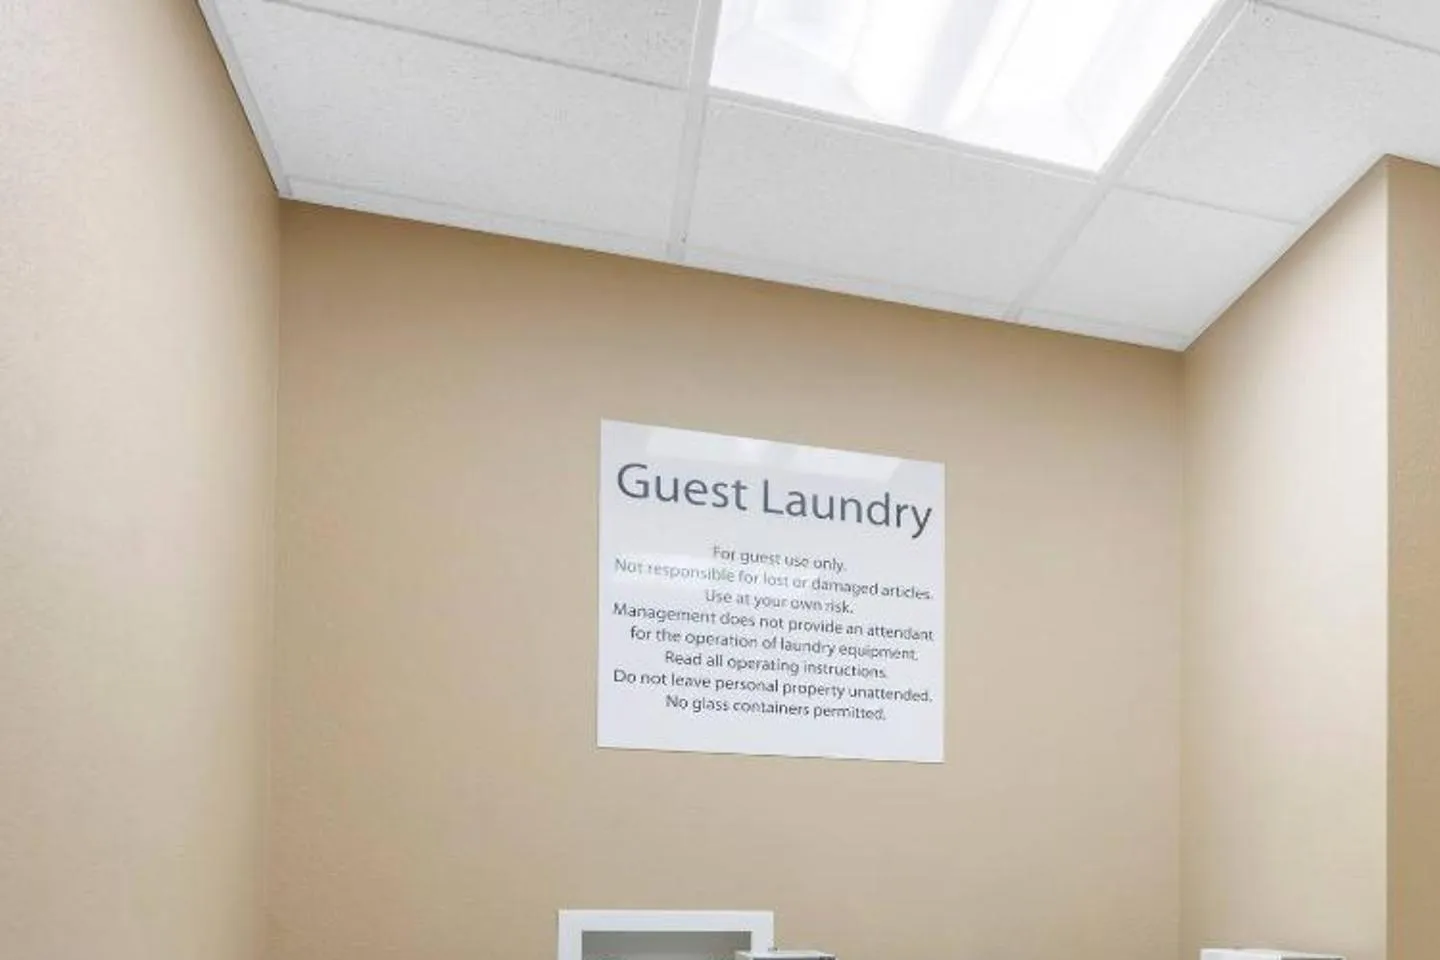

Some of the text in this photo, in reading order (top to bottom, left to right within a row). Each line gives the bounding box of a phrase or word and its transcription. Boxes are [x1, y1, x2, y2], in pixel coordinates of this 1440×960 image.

[617, 463, 933, 538] Guest Laundry
[713, 545, 847, 574] For guest use only.
[615, 557, 934, 600] Not responsible for lost or damaged articles.
[704, 588, 854, 614] Use at your own risk.
[612, 601, 934, 642] Management does not provide an attendant
[630, 625, 651, 640] for
[656, 627, 681, 643] the
[684, 631, 758, 648] operation
[761, 635, 778, 650] of
[780, 636, 836, 657] laundry
[665, 650, 702, 666] Read
[706, 654, 723, 668] all
[727, 657, 799, 676] operating
[613, 669, 933, 702] Do not leave personal property unattended.
[666, 694, 886, 720] No glass containers permitted.
